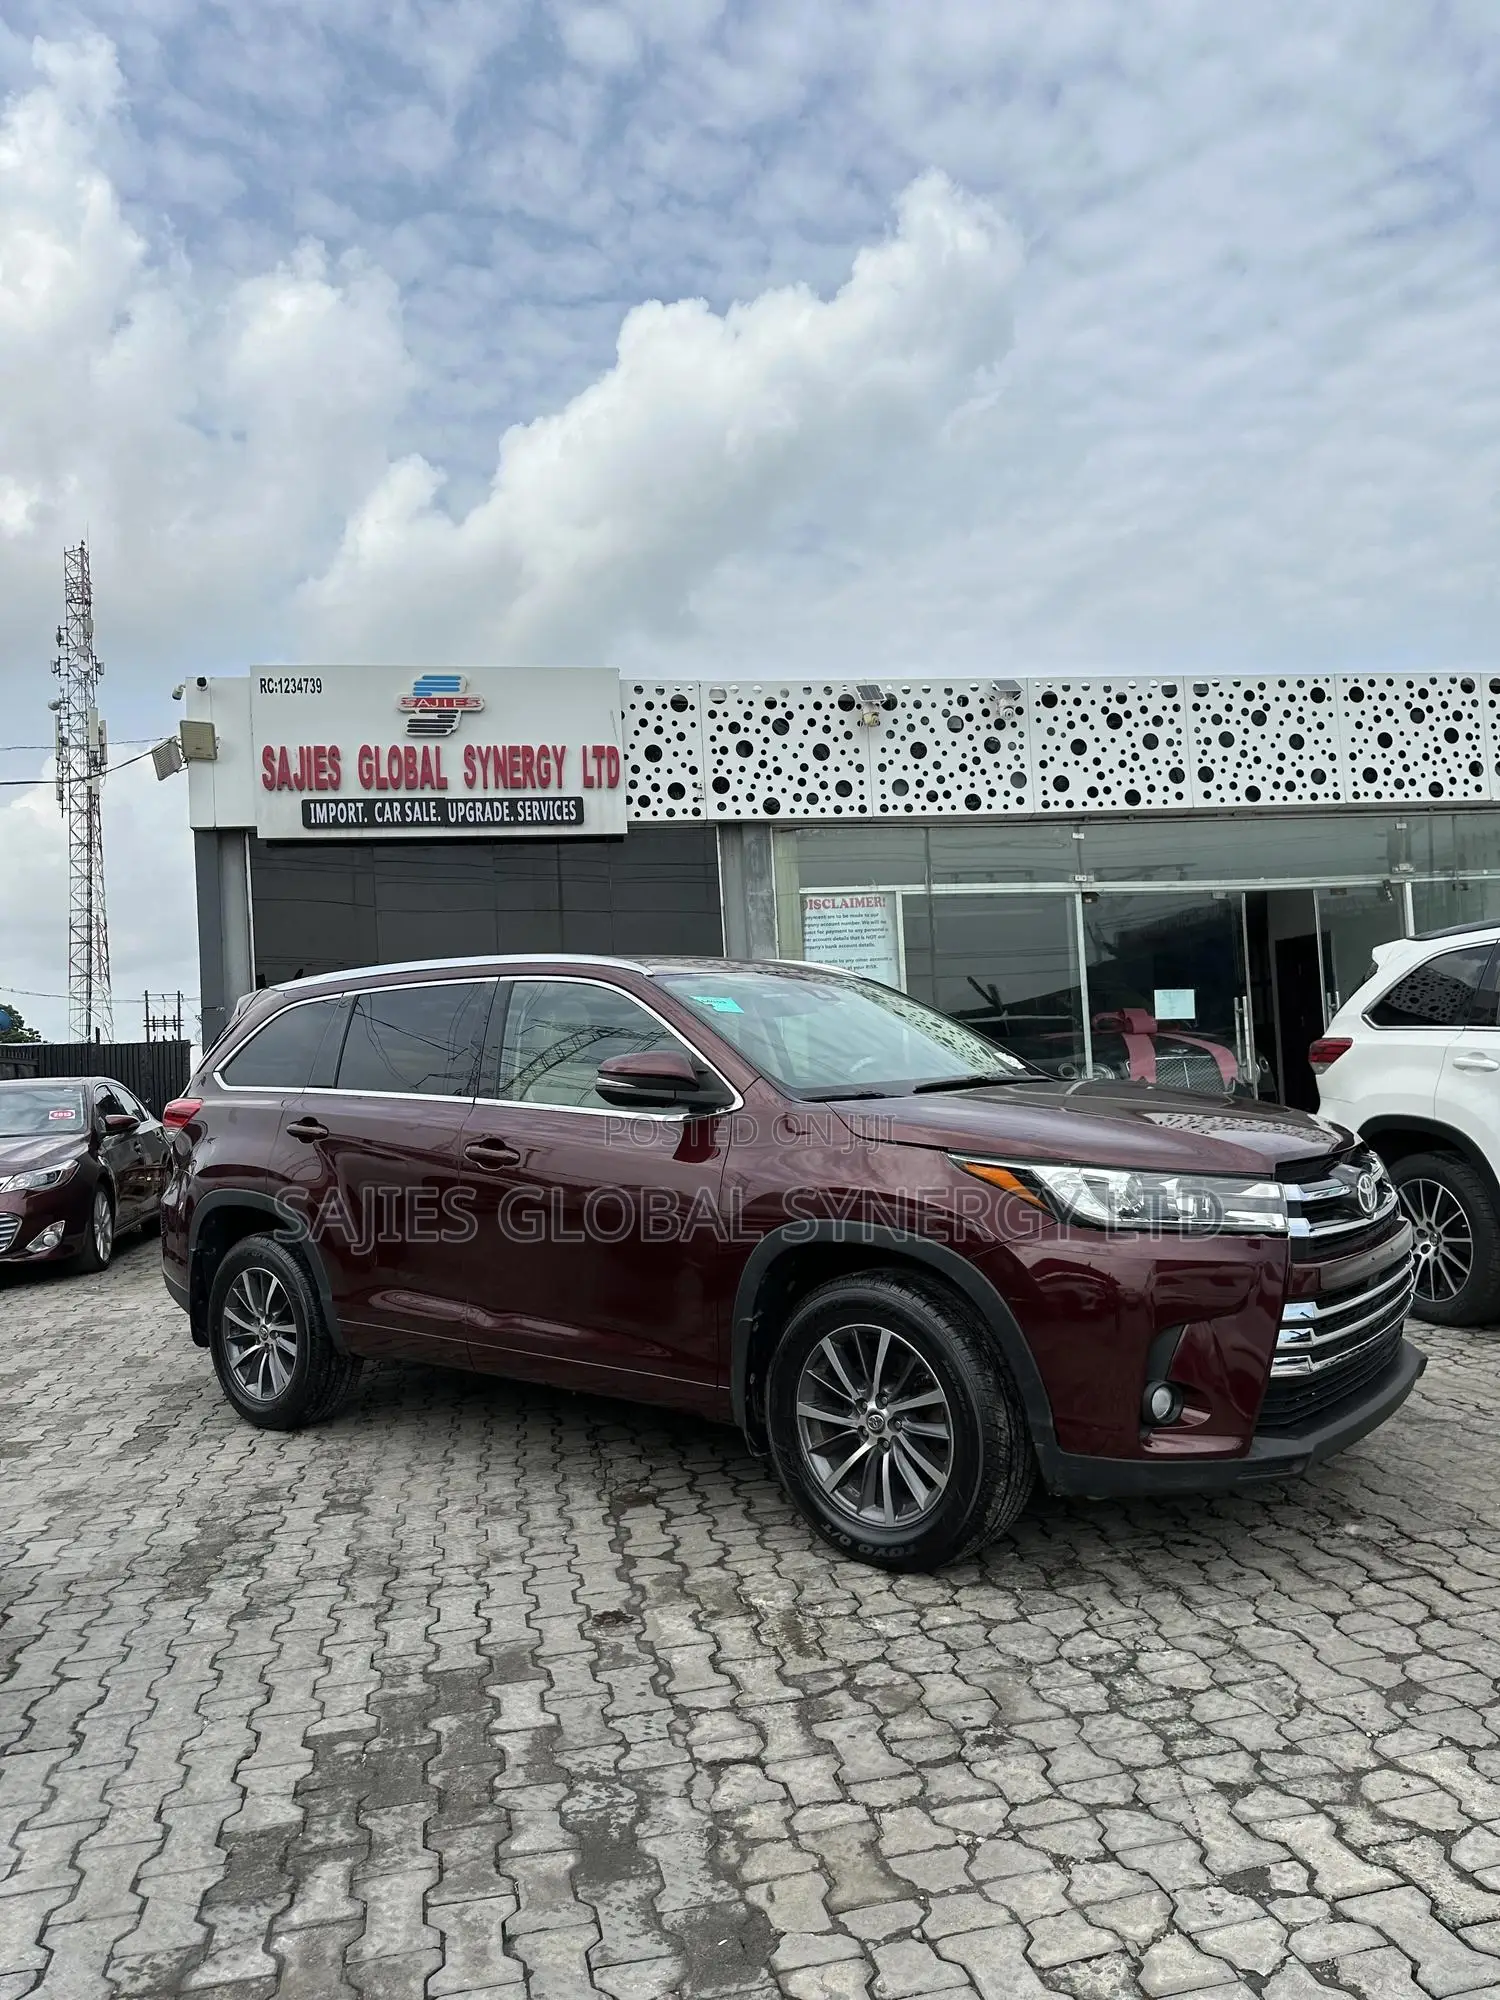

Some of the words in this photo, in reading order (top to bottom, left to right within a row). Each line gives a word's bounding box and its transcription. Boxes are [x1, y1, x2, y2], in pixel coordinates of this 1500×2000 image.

[260, 677, 323, 694] RC:1234739
[401, 697, 481, 708] SAJIES
[261, 744, 341, 791] SAJIES
[358, 744, 448, 790] GLOBAL
[463, 744, 567, 789] SYNERGY
[582, 744, 620, 789] LTD
[309, 802, 368, 824] IMPORT.
[374, 802, 402, 823] CAR
[405, 802, 441, 823] SALE.
[448, 801, 514, 822] UPGRADE.
[517, 800, 577, 821] SERVICES
